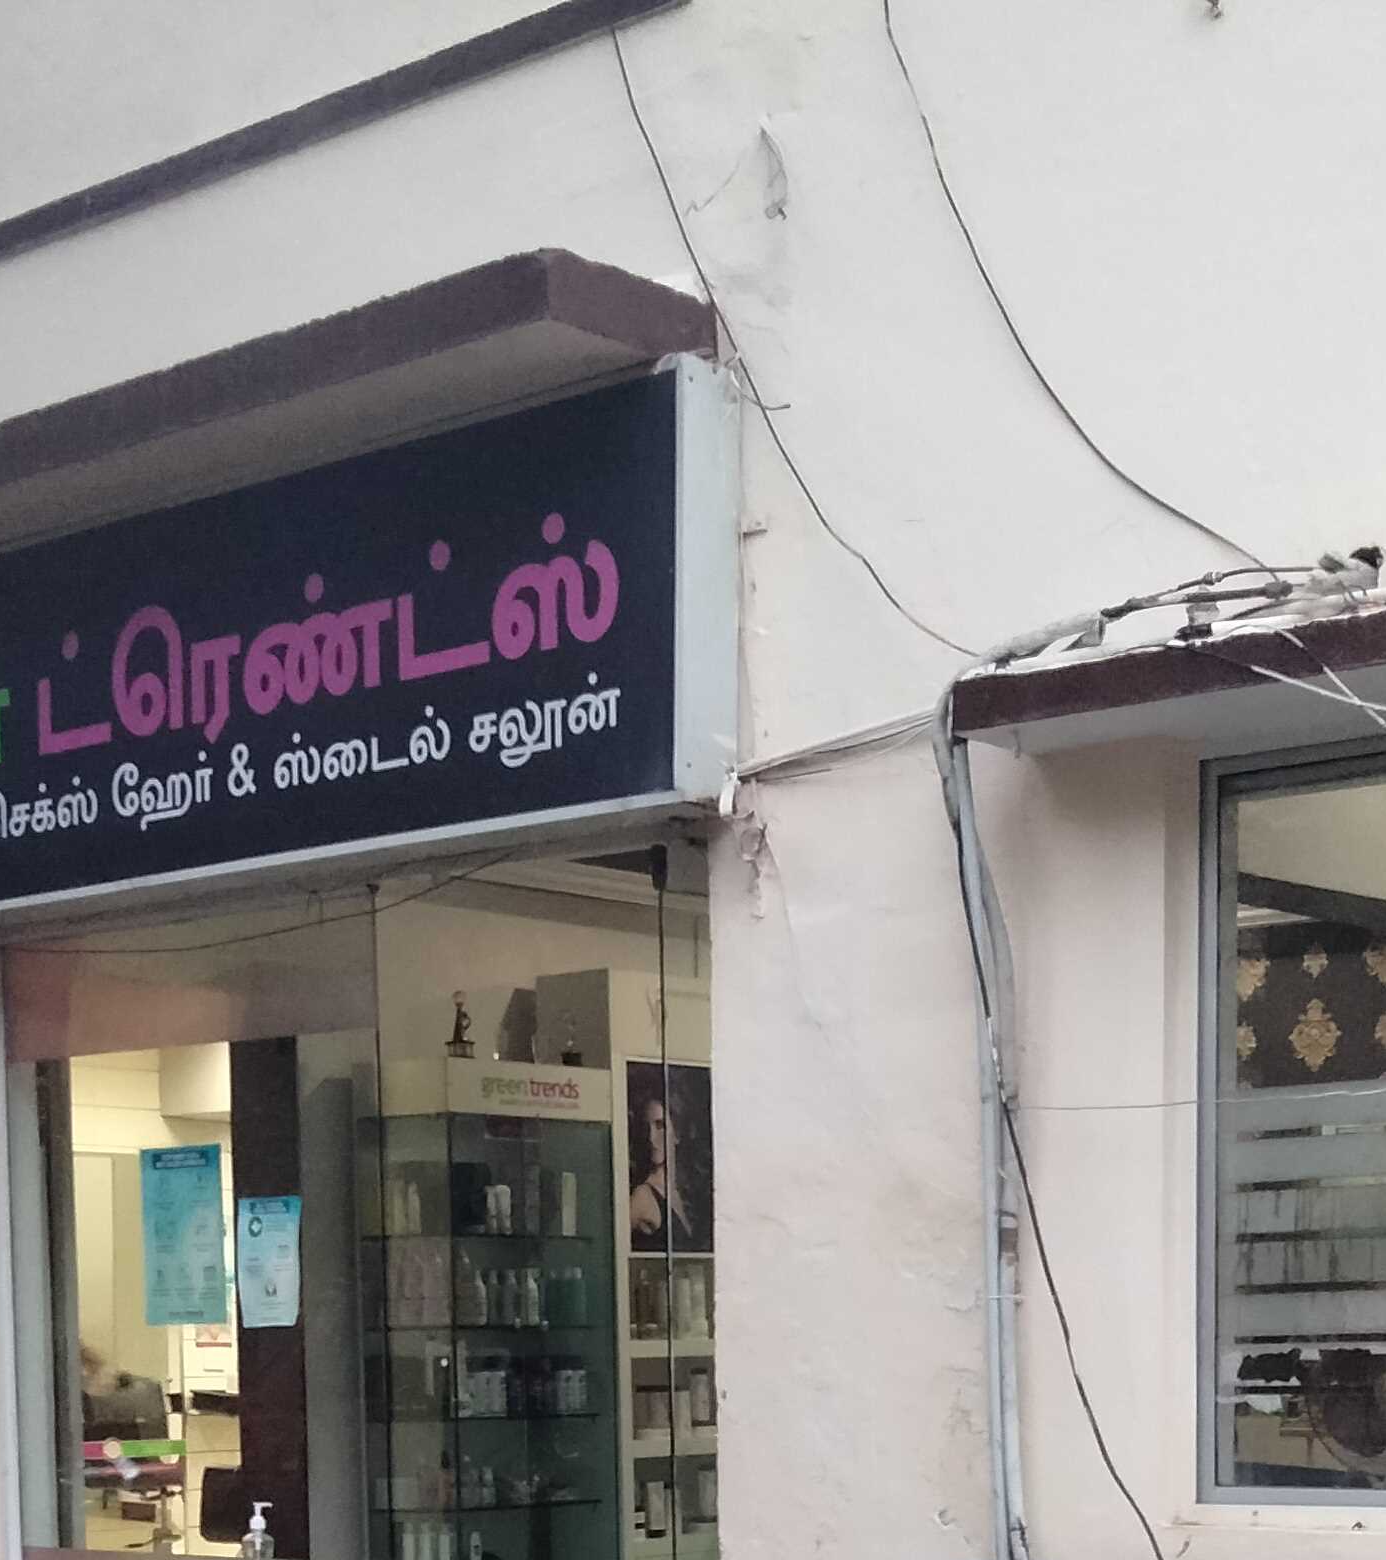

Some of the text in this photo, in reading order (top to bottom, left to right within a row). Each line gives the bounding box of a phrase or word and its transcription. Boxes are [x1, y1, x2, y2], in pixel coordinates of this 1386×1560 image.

[37, 511, 621, 745] ட்ரெண்ட்ஸ்
[113, 749, 214, 832] ஹேர்
[226, 741, 258, 798] &
[273, 704, 452, 791] ஸ்டைல்
[467, 671, 623, 769] சலூன்
